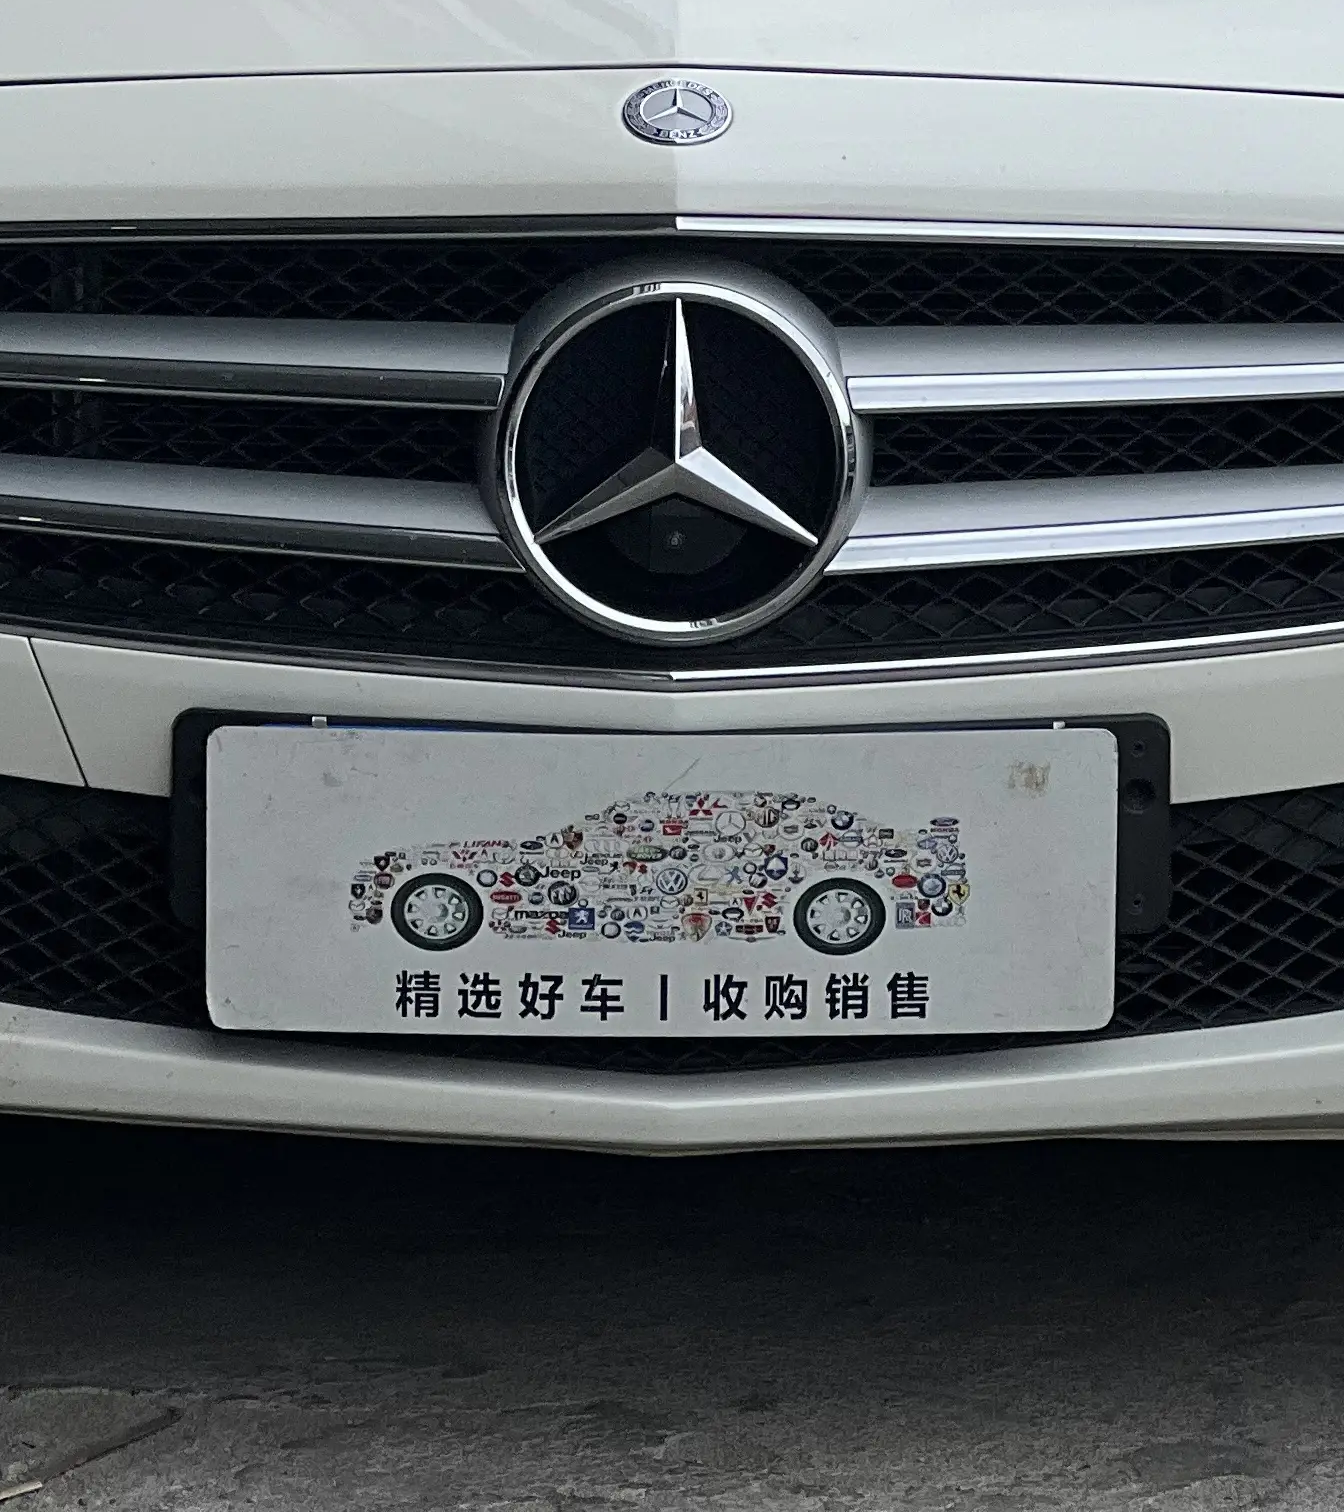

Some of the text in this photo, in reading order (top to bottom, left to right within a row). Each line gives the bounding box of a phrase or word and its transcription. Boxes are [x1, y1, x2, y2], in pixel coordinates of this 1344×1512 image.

[643, 79, 714, 96] MERCEDES
[659, 129, 698, 139] BENZ
[538, 866, 582, 881] Jeep
